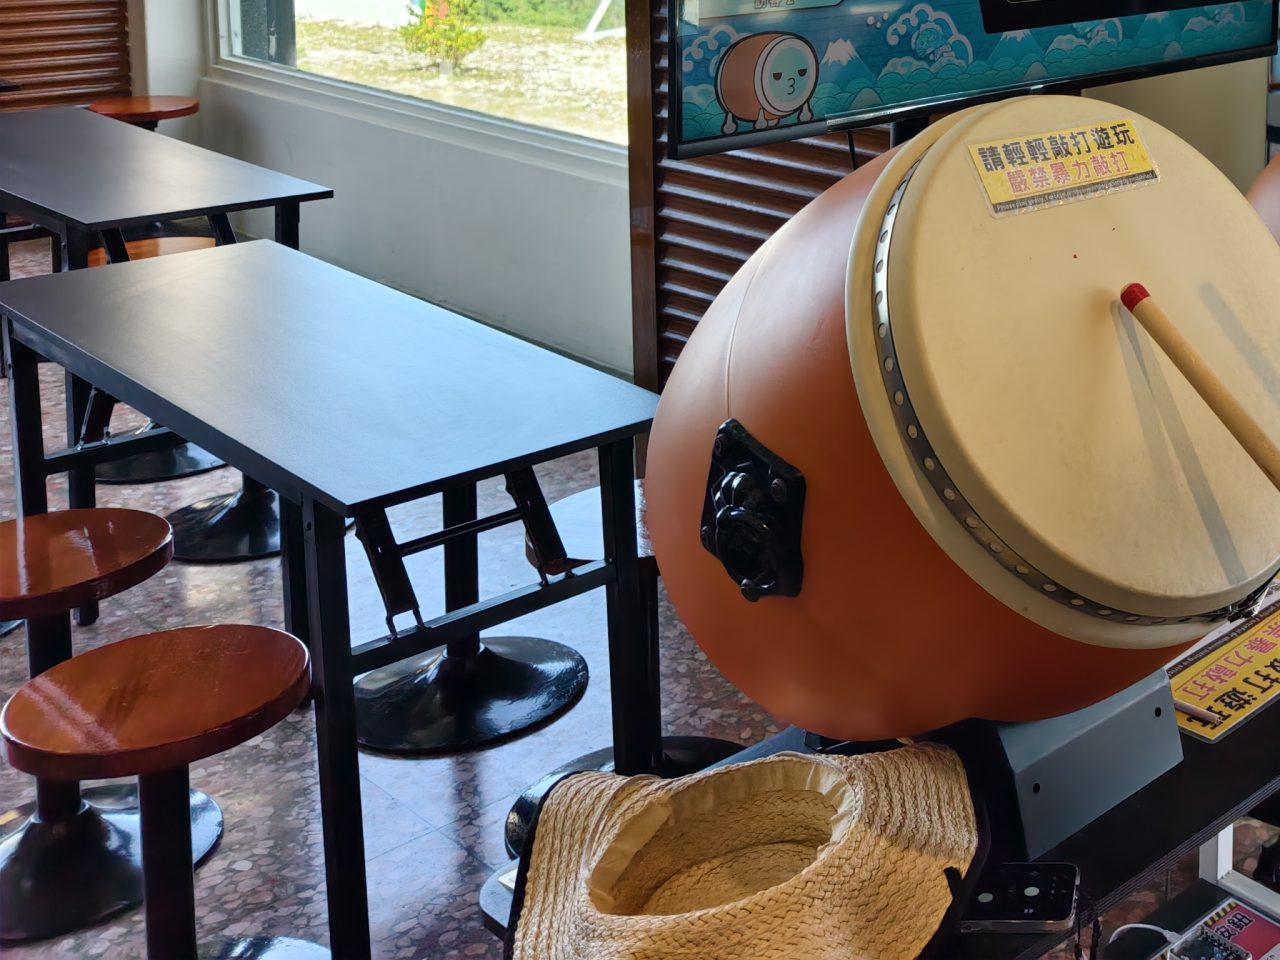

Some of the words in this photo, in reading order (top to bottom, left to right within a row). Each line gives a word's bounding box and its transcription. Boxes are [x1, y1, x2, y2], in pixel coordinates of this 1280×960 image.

[978, 123, 1135, 172] 請輕輕敲打遊玩
[1007, 151, 1129, 194] 嚴禁暴力敲打
